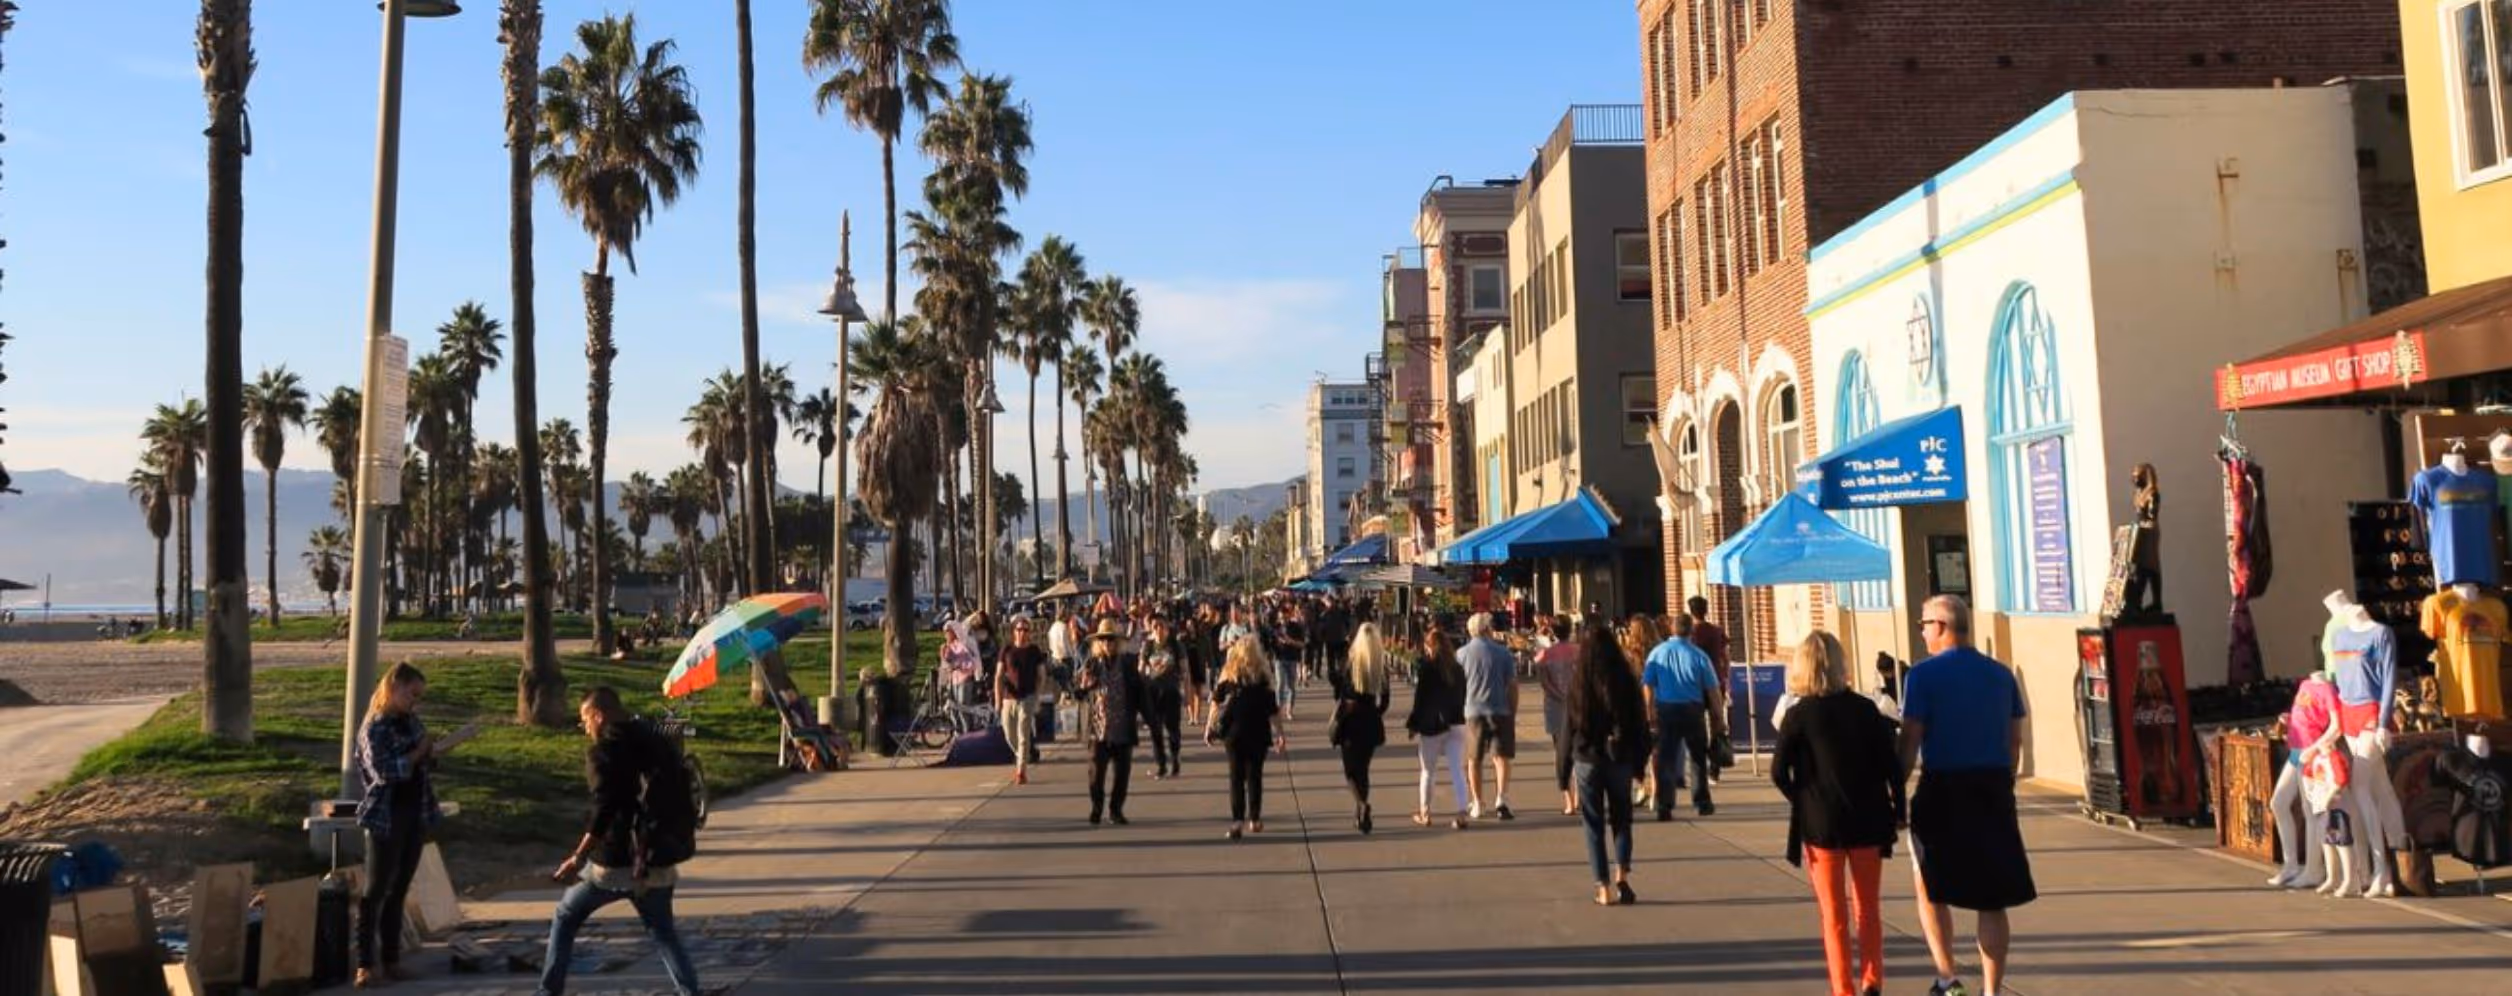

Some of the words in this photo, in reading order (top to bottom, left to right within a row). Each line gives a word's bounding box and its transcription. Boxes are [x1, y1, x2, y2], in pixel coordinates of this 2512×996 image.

[2242, 369, 2288, 396] EGYPTIAN
[2291, 362, 2331, 388] MUSEUM
[2336, 357, 2360, 381] GIFT
[2363, 352, 2391, 377] SHOP
[1874, 457, 1900, 470] Shul
[1840, 479, 1856, 488] on
[1857, 475, 1876, 487] the
